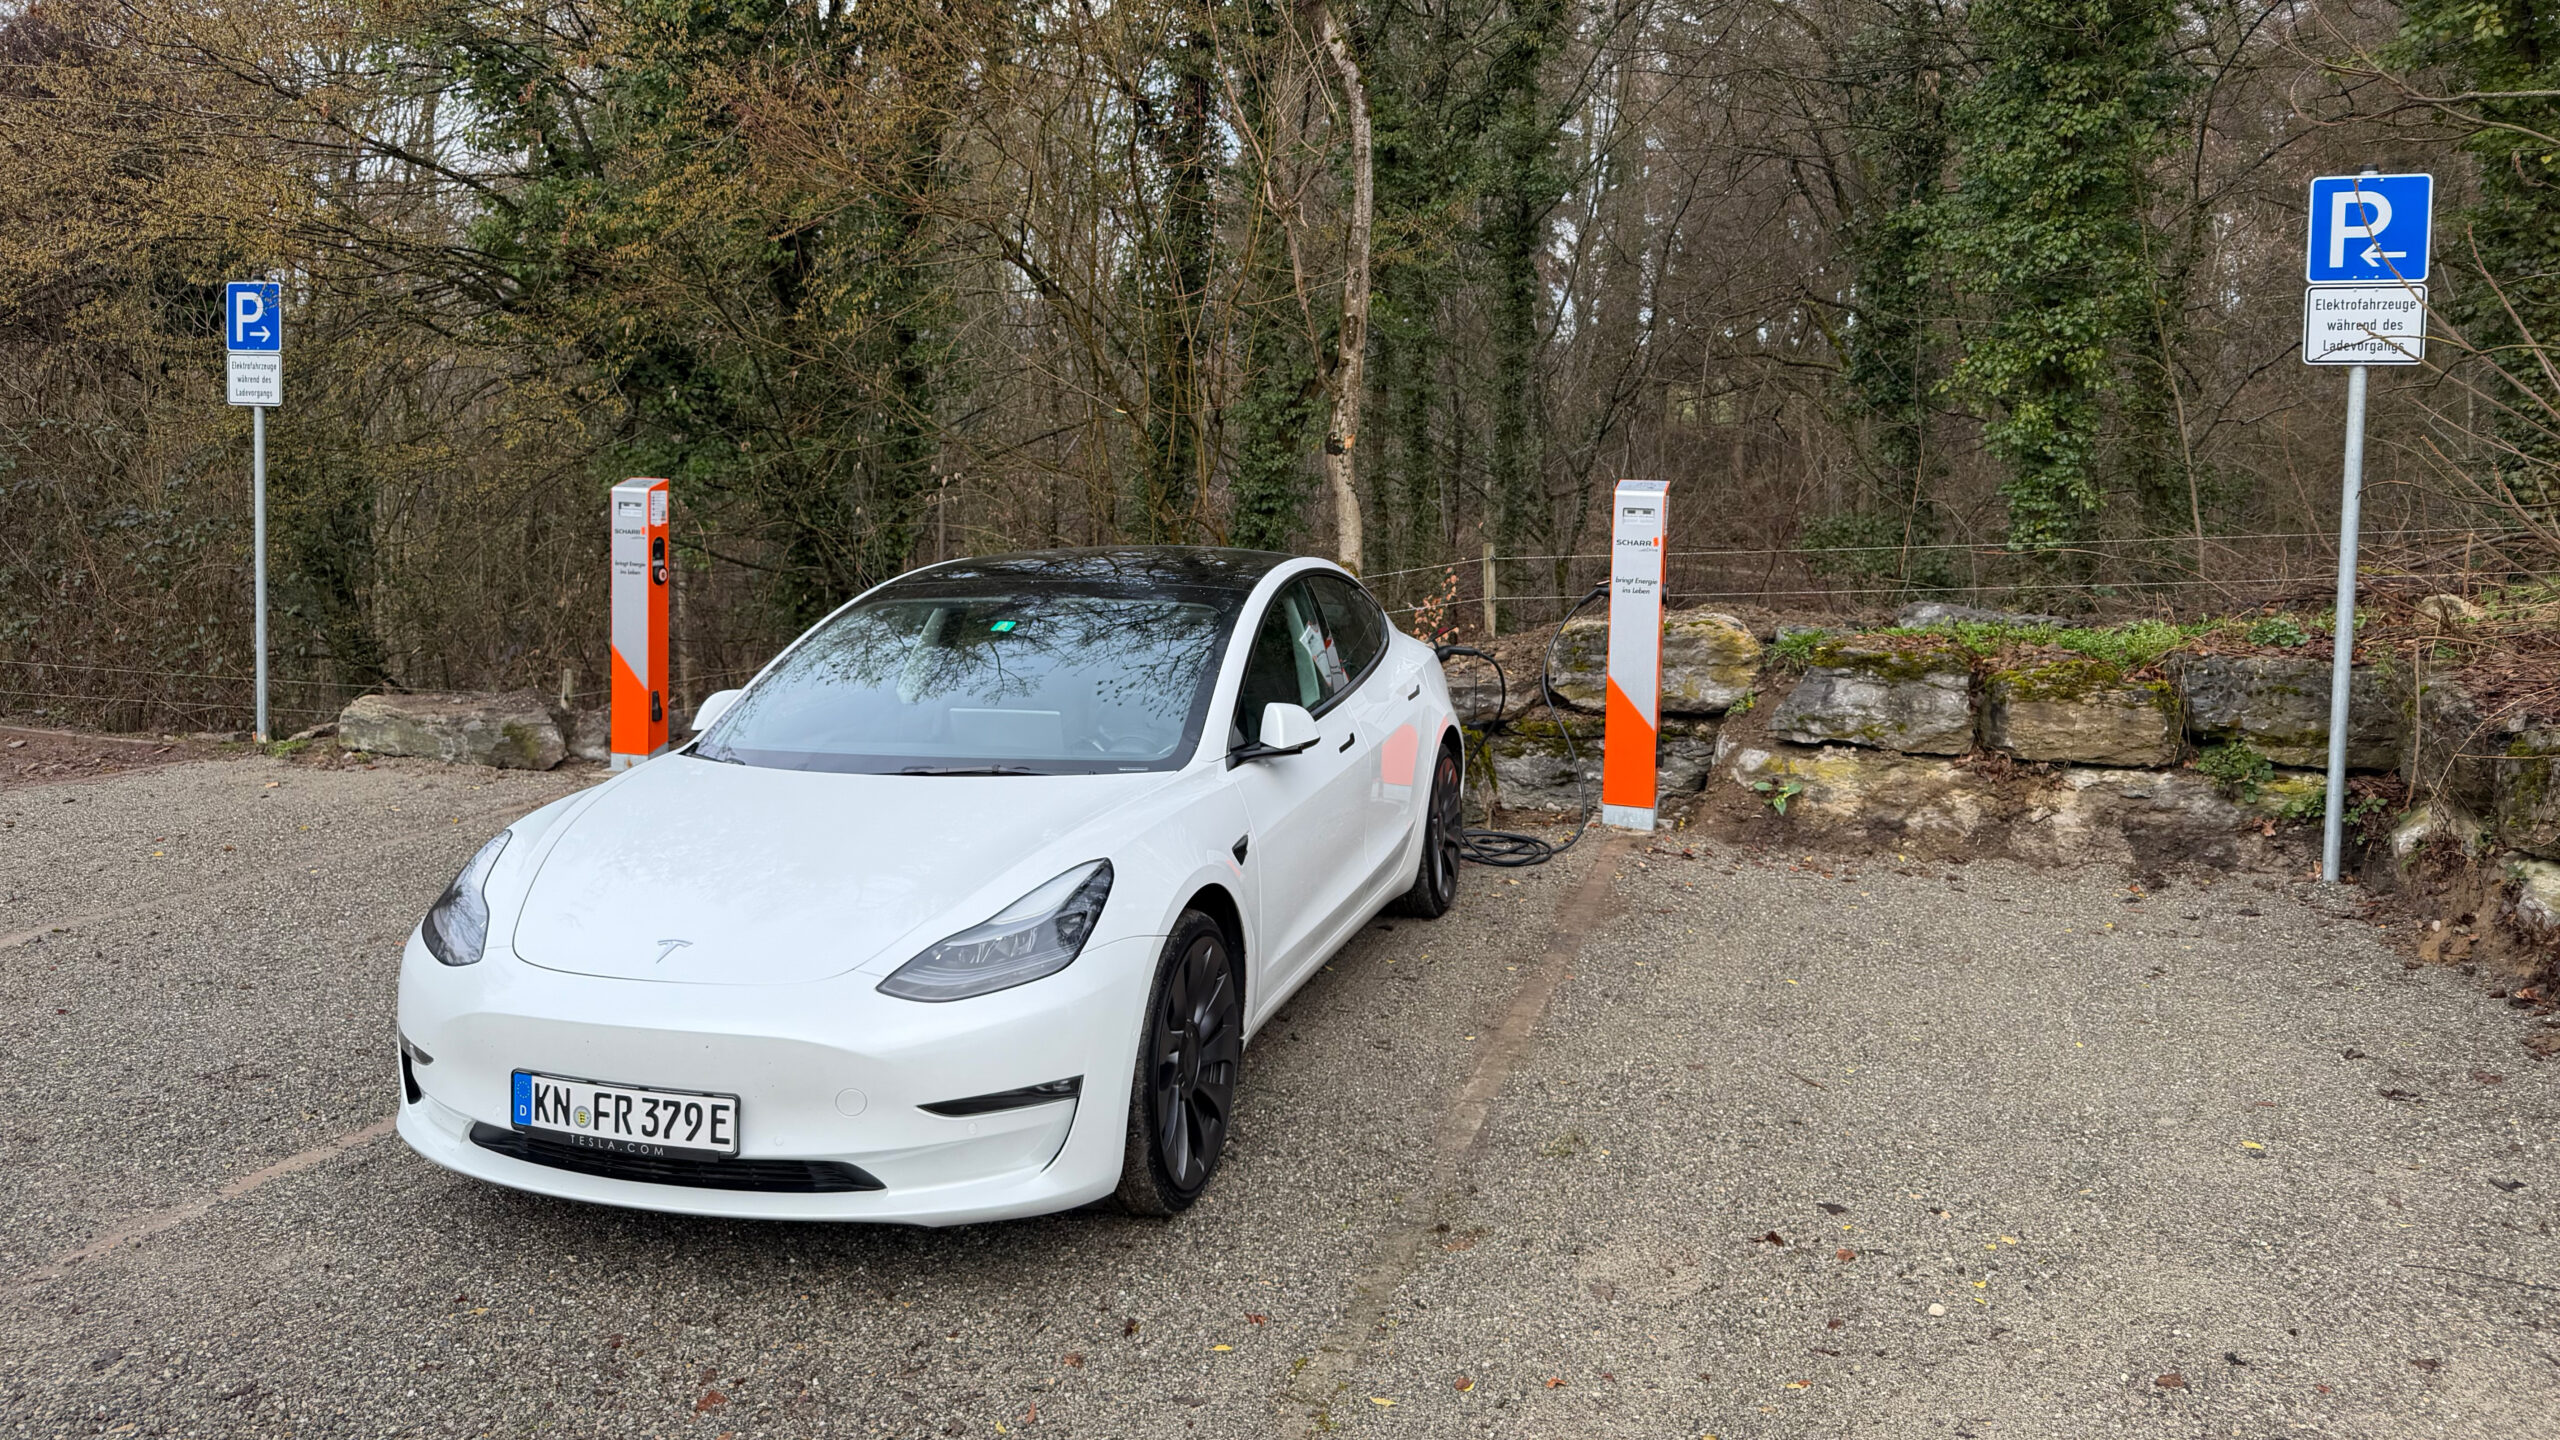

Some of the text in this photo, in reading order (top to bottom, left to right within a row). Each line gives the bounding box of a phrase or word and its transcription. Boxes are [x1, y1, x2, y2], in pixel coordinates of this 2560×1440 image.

[2329, 191, 2393, 268] P
[2315, 298, 2417, 313] Elektrofahrzeuge
[236, 292, 264, 342] P
[2327, 318, 2404, 331] während des
[2323, 340, 2405, 354] Ladevorgangs
[231, 361, 277, 372] Elektrofahrzeuge
[237, 375, 272, 384] während des
[235, 387, 273, 399] Ladevorgangs
[1616, 539, 1652, 547] SCHARR
[1615, 576, 1657, 586] bringt Energie
[518, 1104, 527, 1116] D
[534, 1082, 730, 1145] KN FR 379E
[570, 1134, 664, 1157] TESLA.COM
